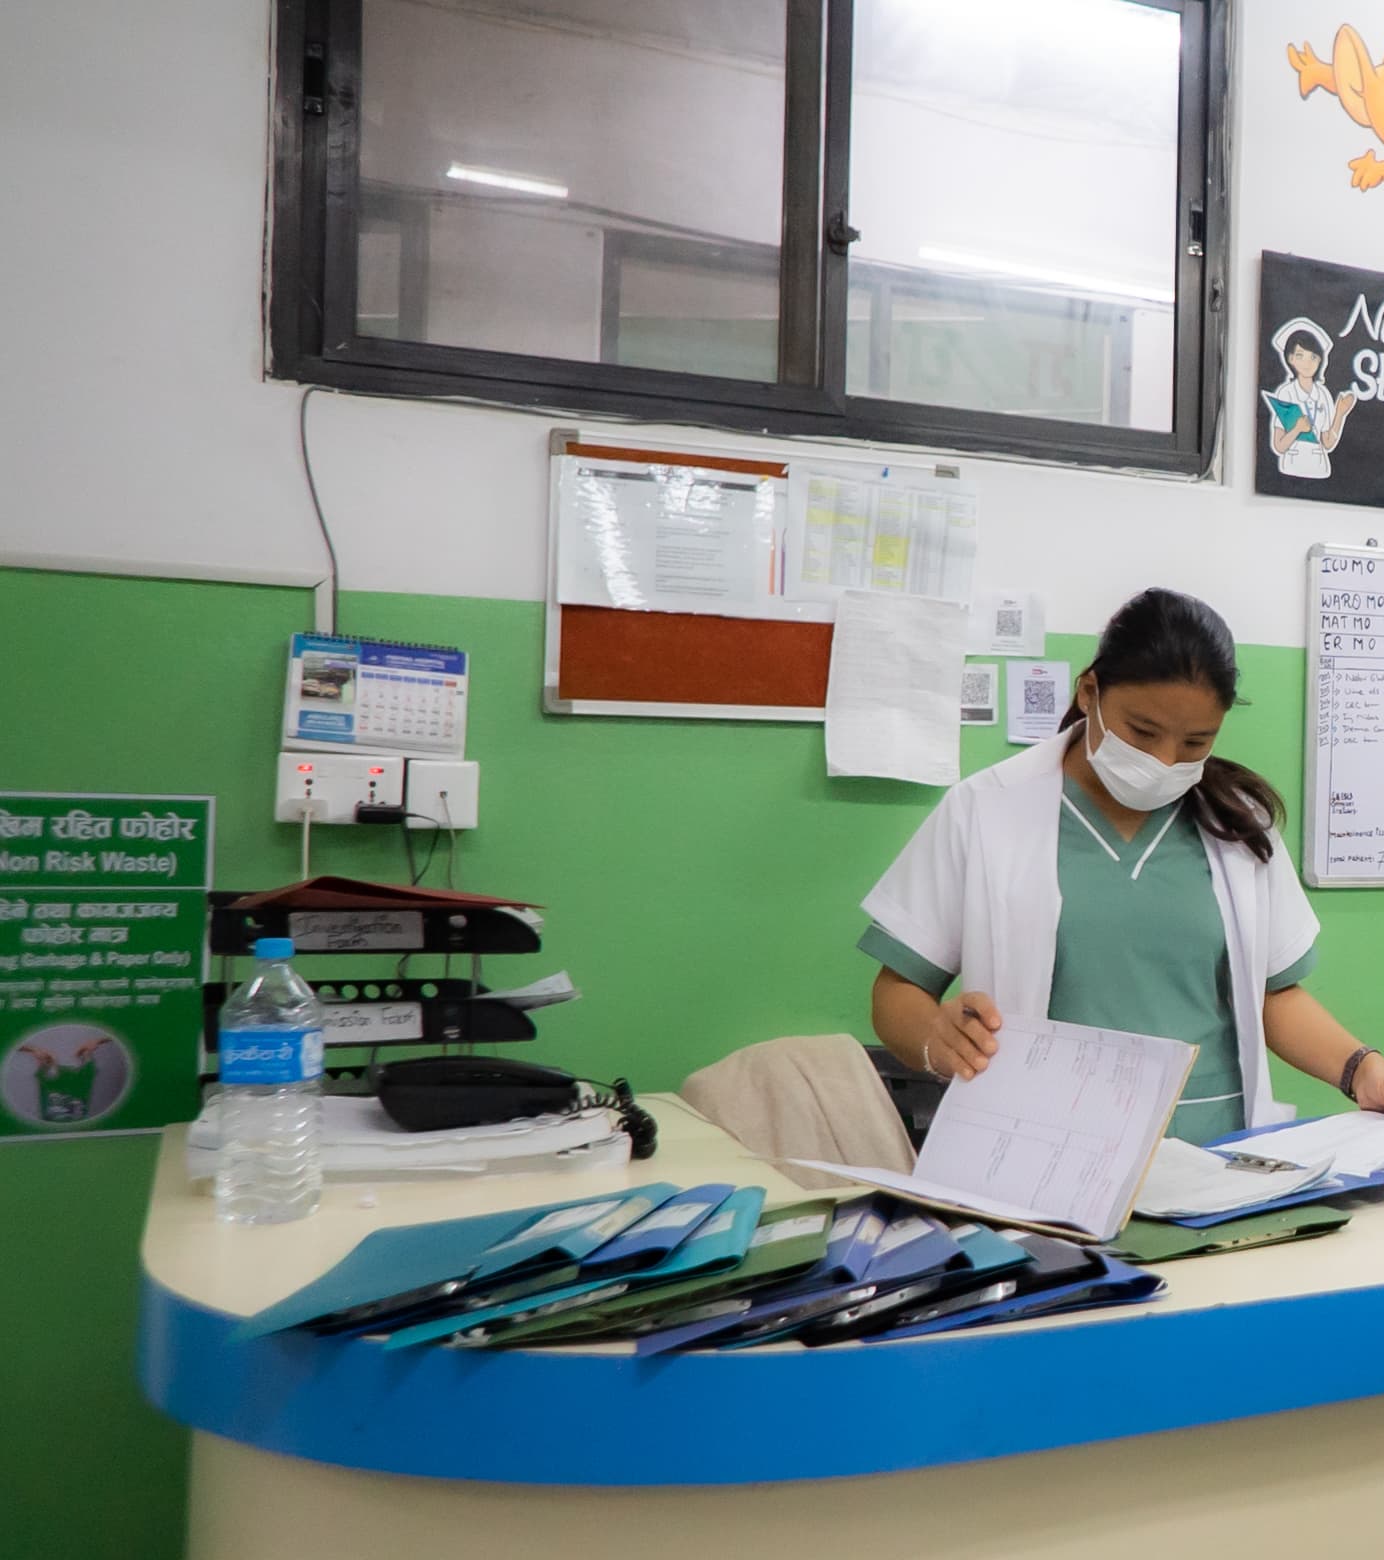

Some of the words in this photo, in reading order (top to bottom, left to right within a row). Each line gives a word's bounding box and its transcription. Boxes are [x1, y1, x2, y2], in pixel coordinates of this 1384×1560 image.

[1321, 557, 1348, 573] ICU
[1323, 633, 1342, 651] ER
[1353, 637, 1377, 651] MO
[50, 809, 115, 840] रहित
[119, 811, 200, 841] फोहोर
[45, 850, 97, 873] Risk
[102, 851, 178, 879] Waste)
[21, 951, 88, 970] Garbage
[90, 951, 104, 966] &
[107, 951, 150, 968] Paper
[152, 950, 192, 968] Only)
